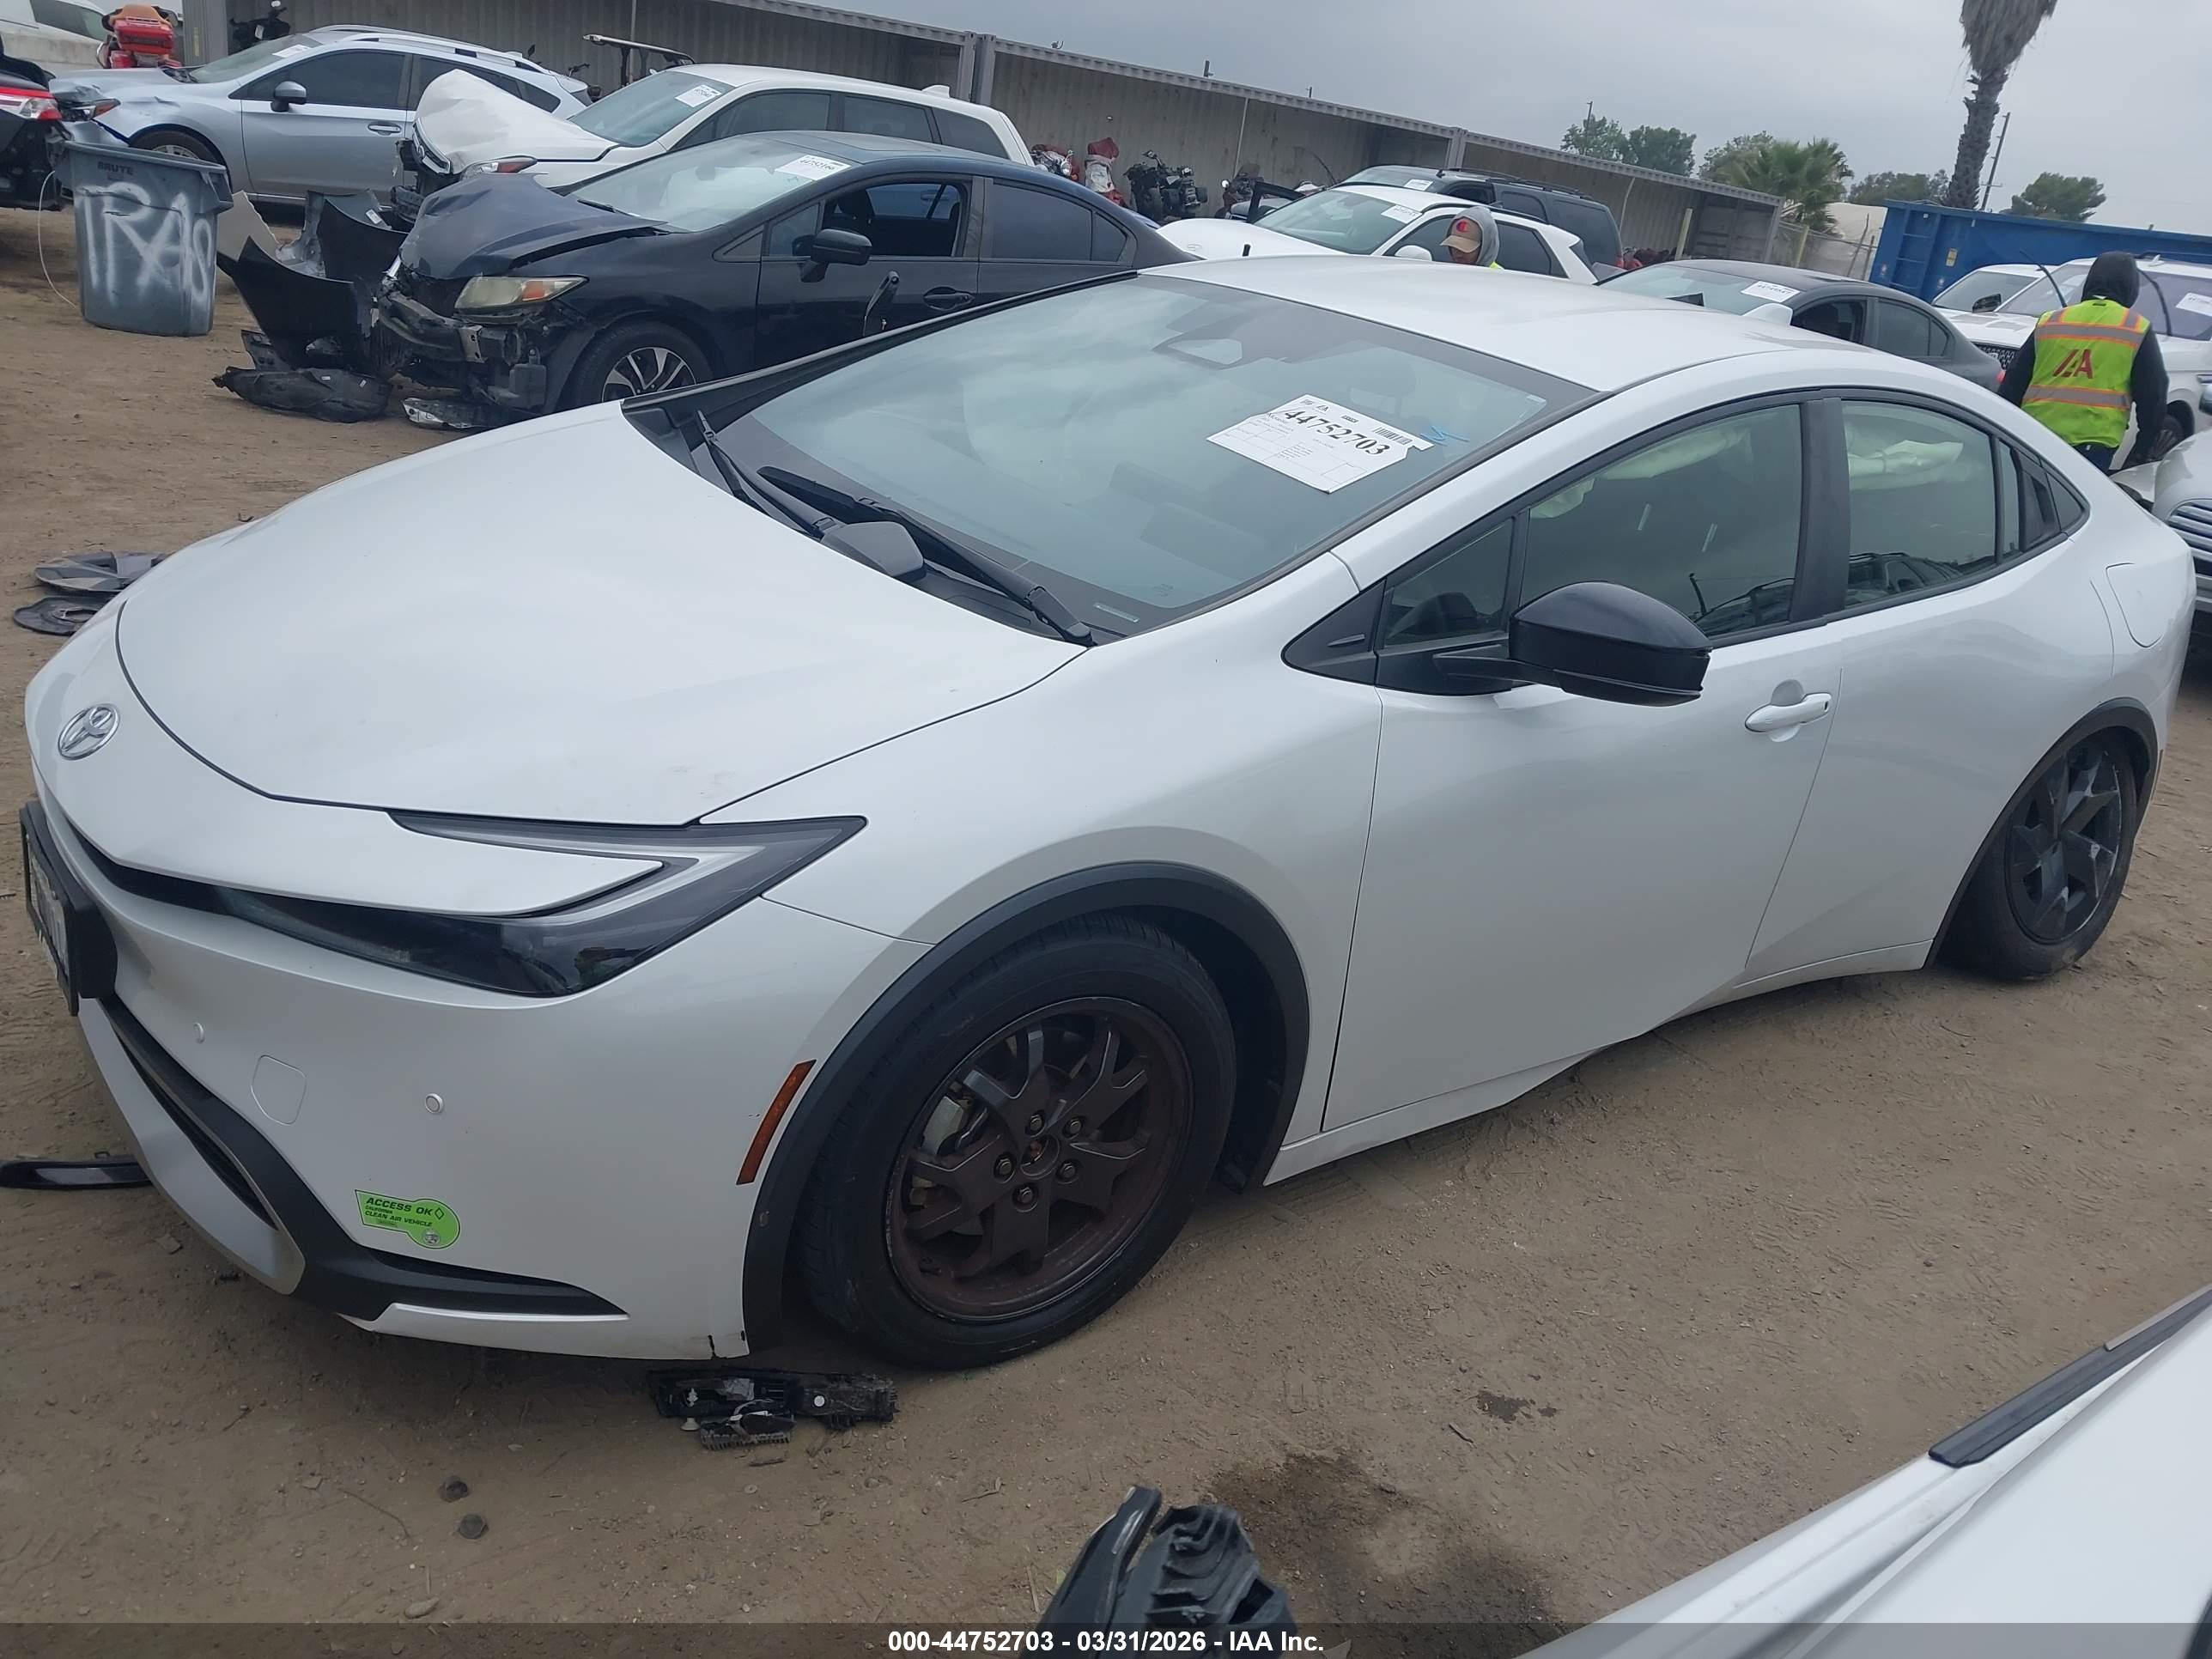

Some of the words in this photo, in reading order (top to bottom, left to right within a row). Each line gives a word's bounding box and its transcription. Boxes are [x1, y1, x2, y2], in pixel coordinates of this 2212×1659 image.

[97, 161, 134, 175] BRUTE
[1285, 410, 1390, 454] 44752703
[367, 1197, 412, 1212] ACCESS
[416, 1206, 434, 1216] OK
[365, 1210, 387, 1219] CLEAN
[404, 1217, 433, 1227] VEHICLE
